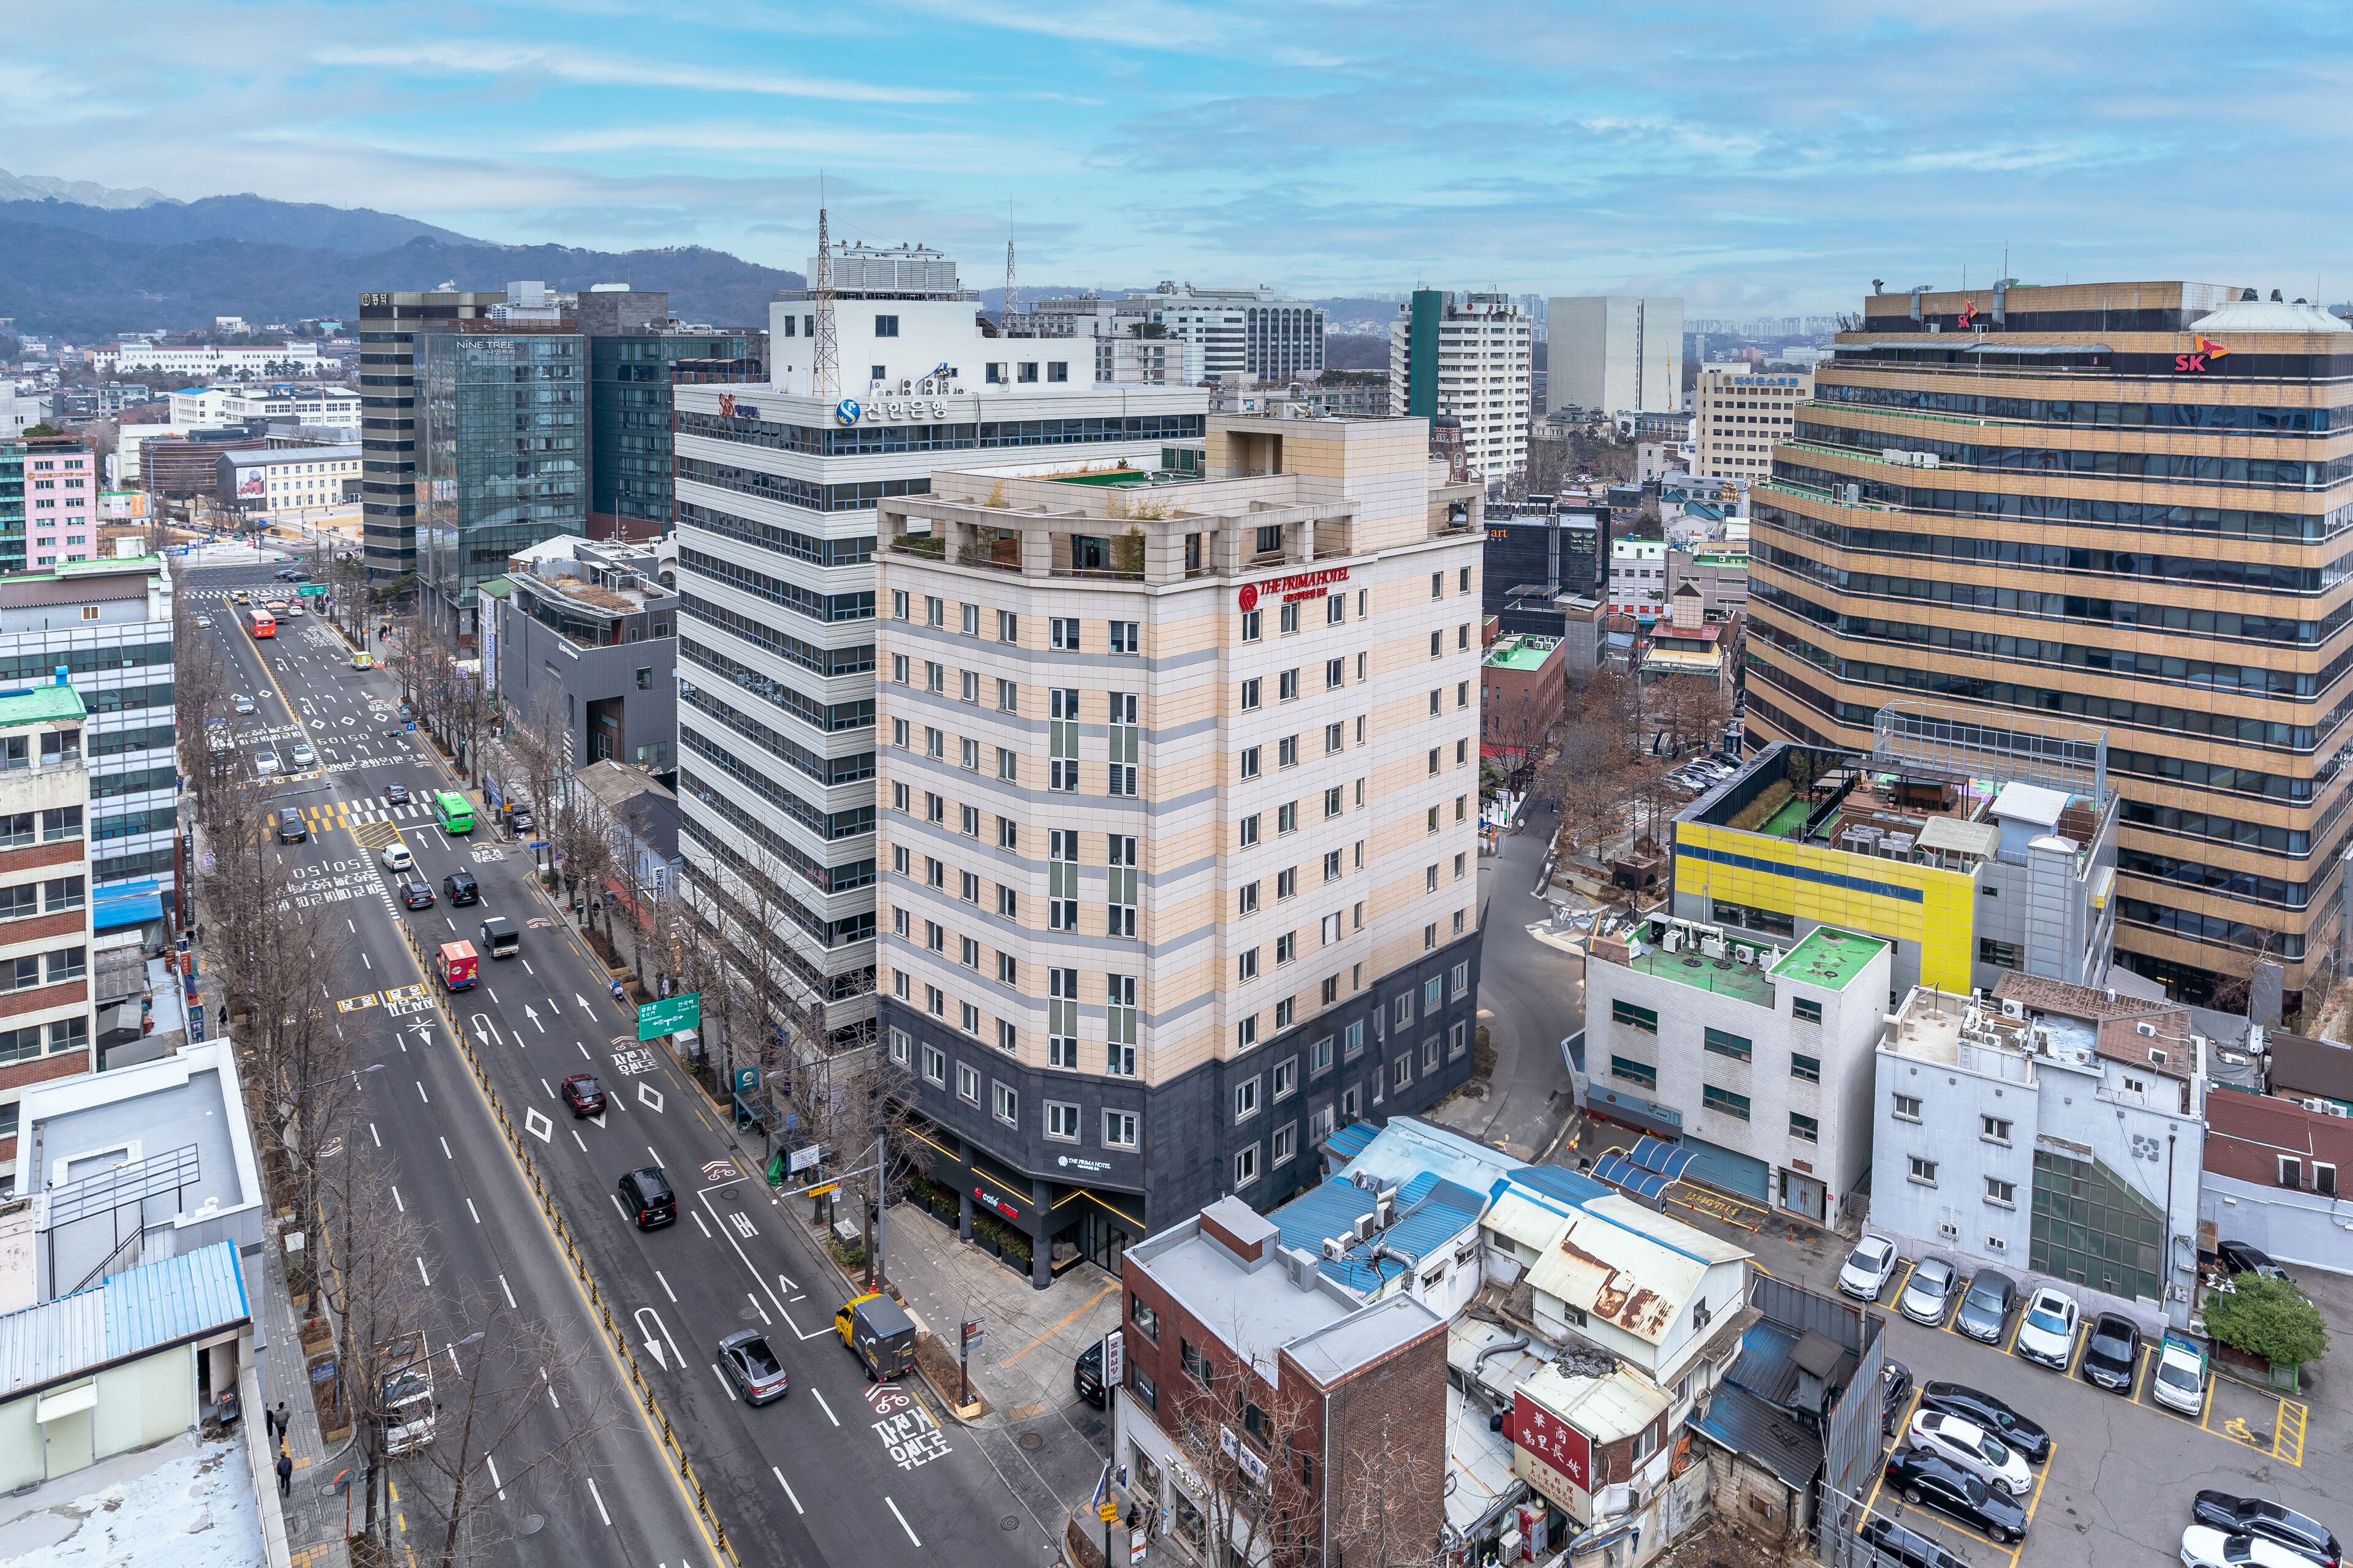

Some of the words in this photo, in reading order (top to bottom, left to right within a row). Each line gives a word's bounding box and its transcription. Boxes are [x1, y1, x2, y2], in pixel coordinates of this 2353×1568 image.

[373, 294, 387, 306] 동덕
[1958, 314, 1970, 328] SK
[2175, 354, 2205, 371] SK
[865, 400, 947, 421] 신한은행
[1491, 529, 1507, 538] art
[1260, 578, 1282, 595] THE
[1282, 574, 1316, 591] PRIMA
[1316, 567, 1350, 586] HOTEL
[469, 849, 502, 858] 자전거
[293, 866, 320, 879] 50
[333, 859, 362, 871] 50
[333, 871, 374, 887] 보호구역
[337, 883, 379, 901] 어린이
[387, 995, 436, 1017] 직진금지
[641, 1004, 657, 1013] 광화문
[678, 999, 694, 1008] 안국역
[610, 1048, 653, 1066] 자전거
[618, 1058, 661, 1076] 우선도로
[982, 1193, 999, 1207] café
[871, 1406, 935, 1449] 자전거
[889, 1429, 953, 1471] 우선도로
[1523, 1428, 1582, 1479] 萬里長城
[1530, 1460, 1574, 1495] 中華料理
